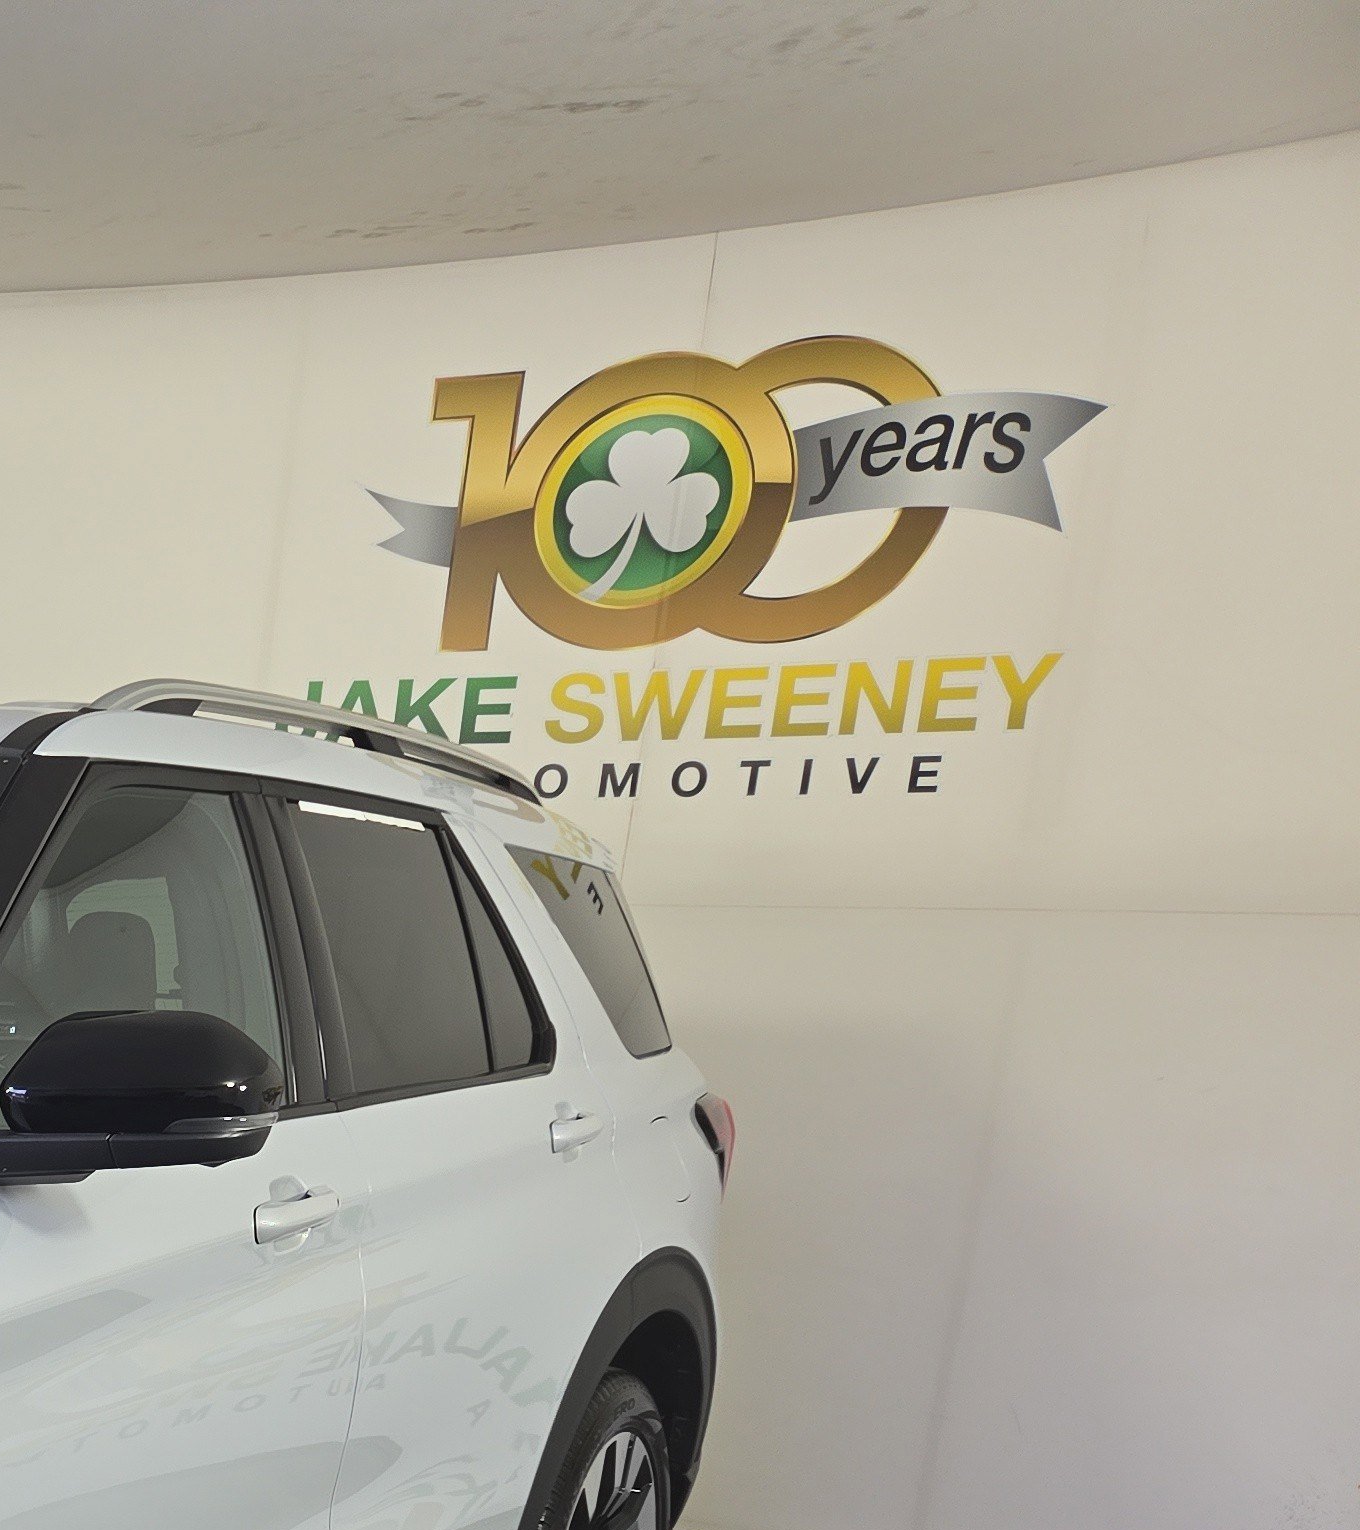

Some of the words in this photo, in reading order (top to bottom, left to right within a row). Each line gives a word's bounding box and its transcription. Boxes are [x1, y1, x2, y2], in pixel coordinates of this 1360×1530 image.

[808, 410, 1034, 507] years
[544, 652, 1064, 746] SWEENEY
[533, 755, 944, 799] OMOTIVE
